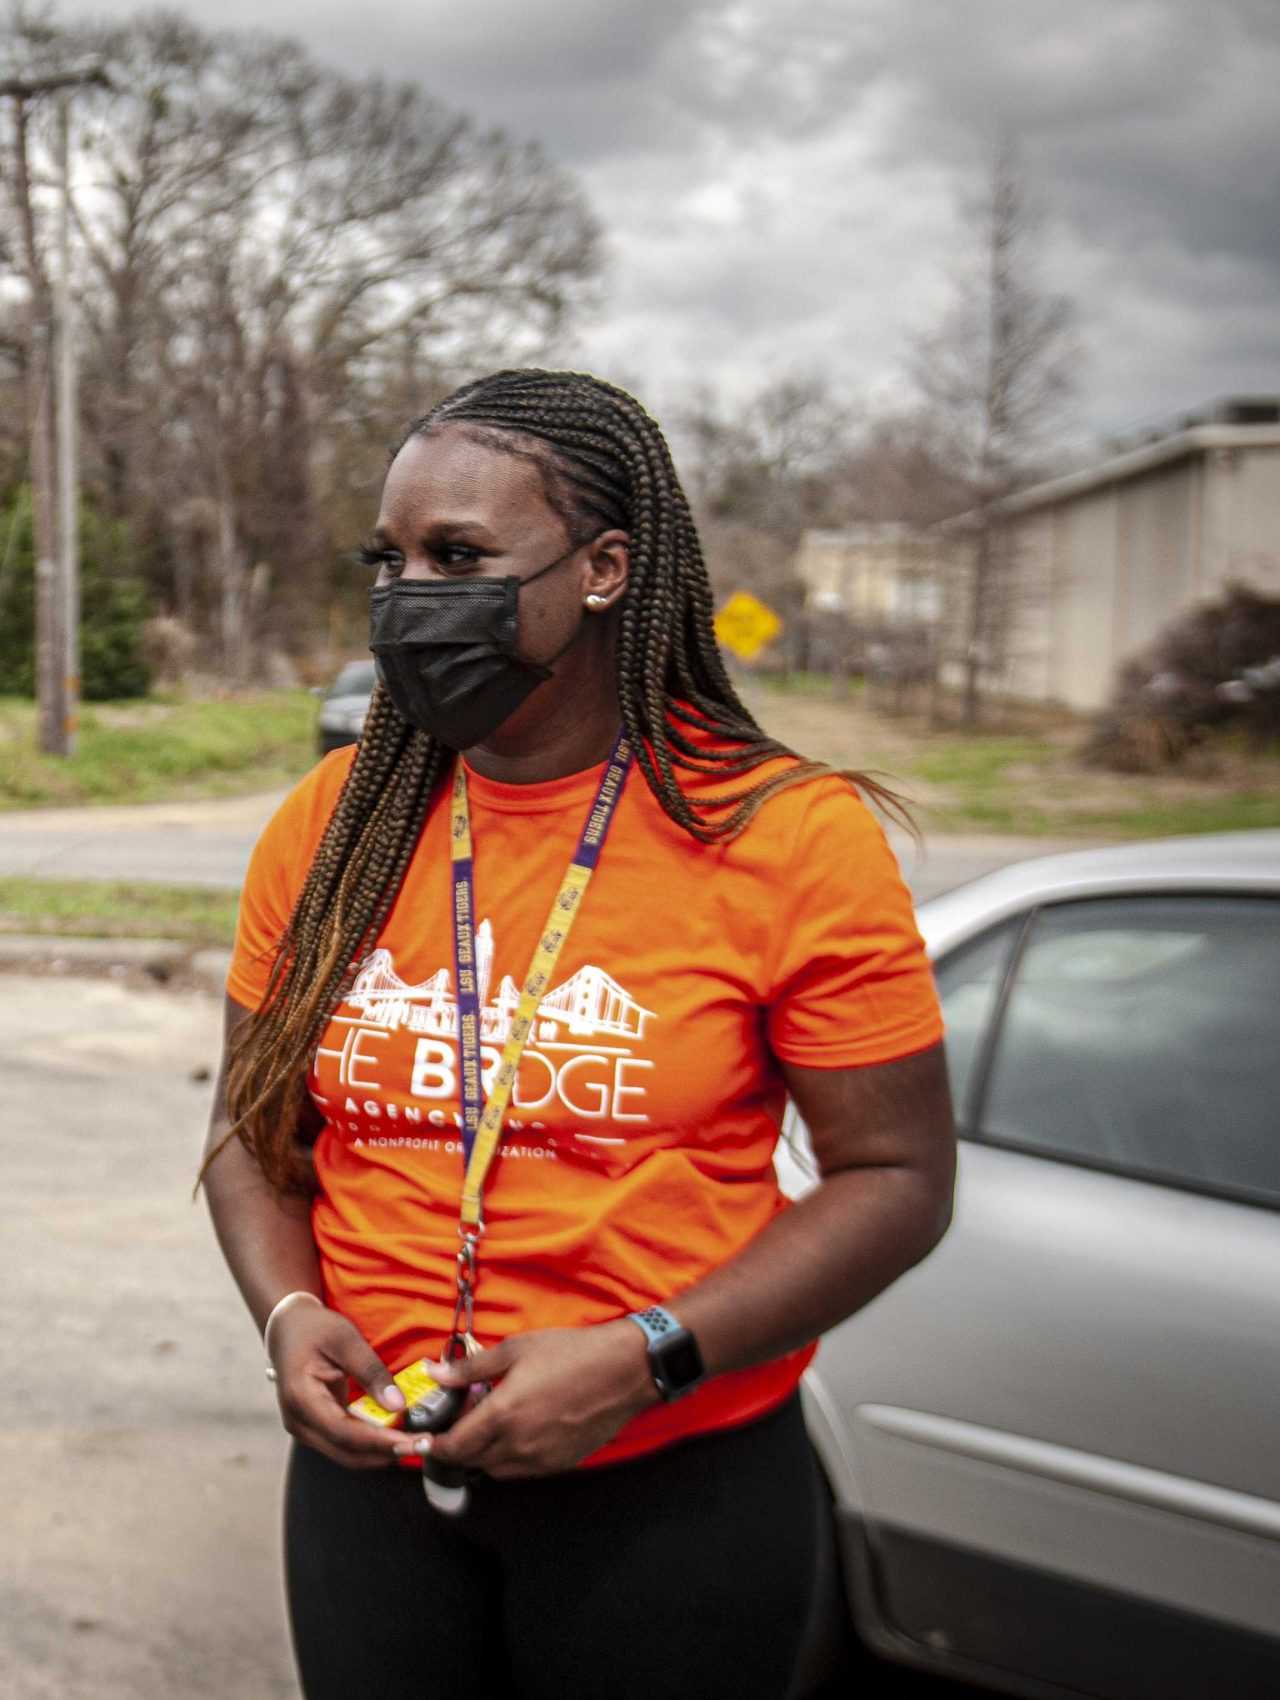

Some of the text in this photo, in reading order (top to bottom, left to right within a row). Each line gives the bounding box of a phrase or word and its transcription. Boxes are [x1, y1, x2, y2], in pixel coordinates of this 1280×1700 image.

[457, 923, 472, 965] GEAUX
[313, 1026, 655, 1122] HE BRDGE
[463, 1060, 479, 1101] GEAUX
[353, 1137, 365, 1149] A
[368, 1136, 440, 1151] NONPROFIT
